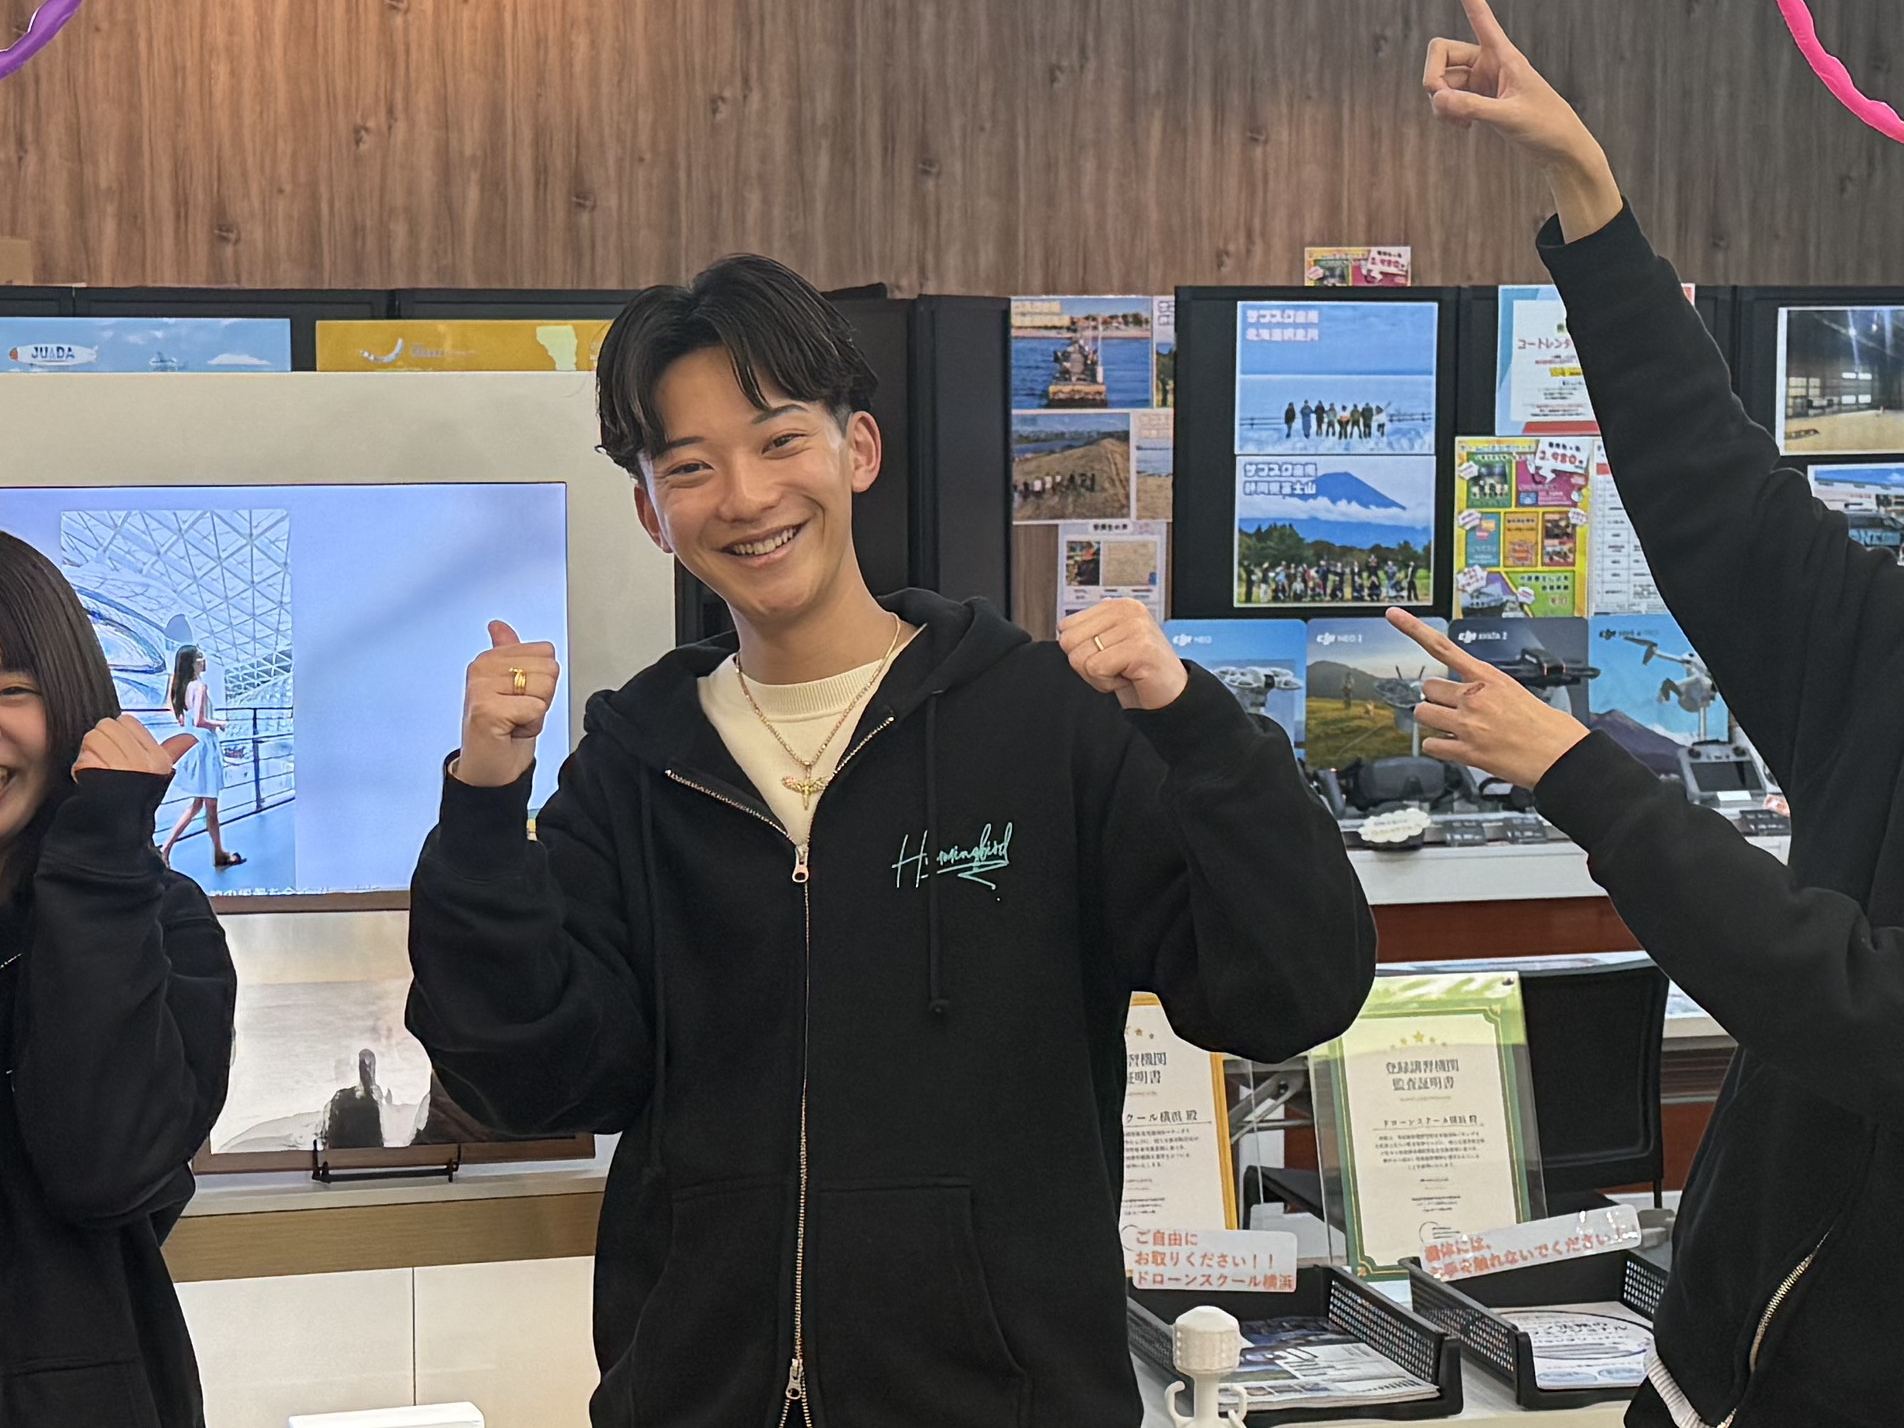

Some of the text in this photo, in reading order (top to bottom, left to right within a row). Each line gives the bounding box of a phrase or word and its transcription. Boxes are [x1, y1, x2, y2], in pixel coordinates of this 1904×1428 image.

[1137, 1230, 1198, 1246] ご自由に
[1137, 1270, 1294, 1289] ドローンスクール横浜
